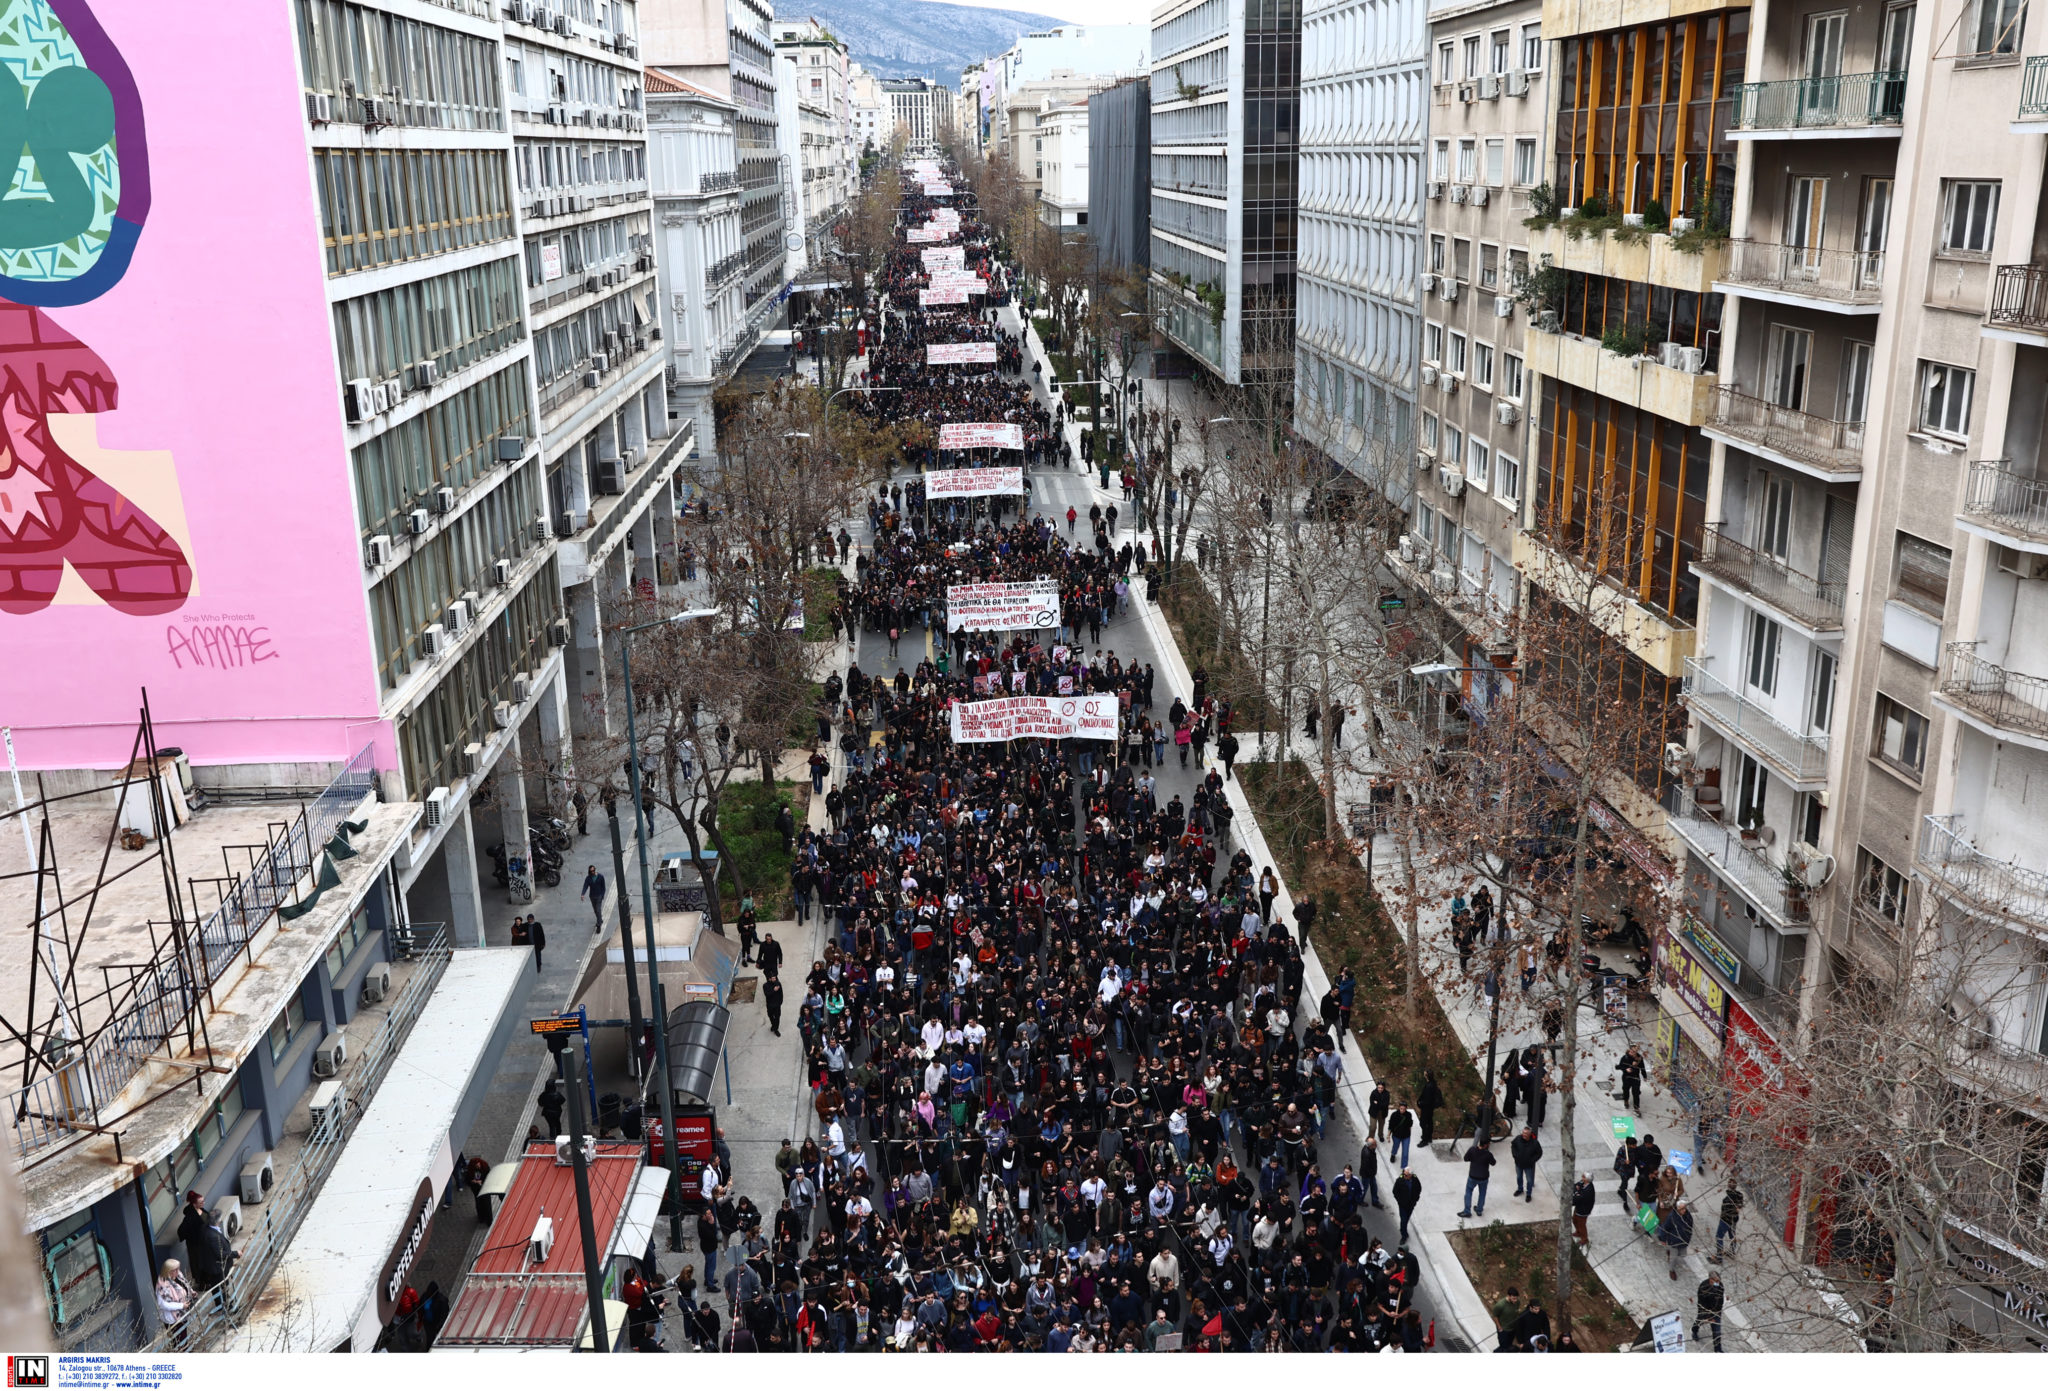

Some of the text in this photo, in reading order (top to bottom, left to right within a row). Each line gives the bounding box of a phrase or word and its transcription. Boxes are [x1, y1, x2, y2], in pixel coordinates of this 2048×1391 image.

[984, 598, 991, 606] ΔΕ
[992, 598, 1001, 606] ΘΑ
[950, 608, 957, 616] ΤΟ
[183, 613, 255, 622] She Who Protects
[1085, 701, 1101, 716] ΦΣ
[389, 1196, 434, 1302] COFFEE ISLAND
